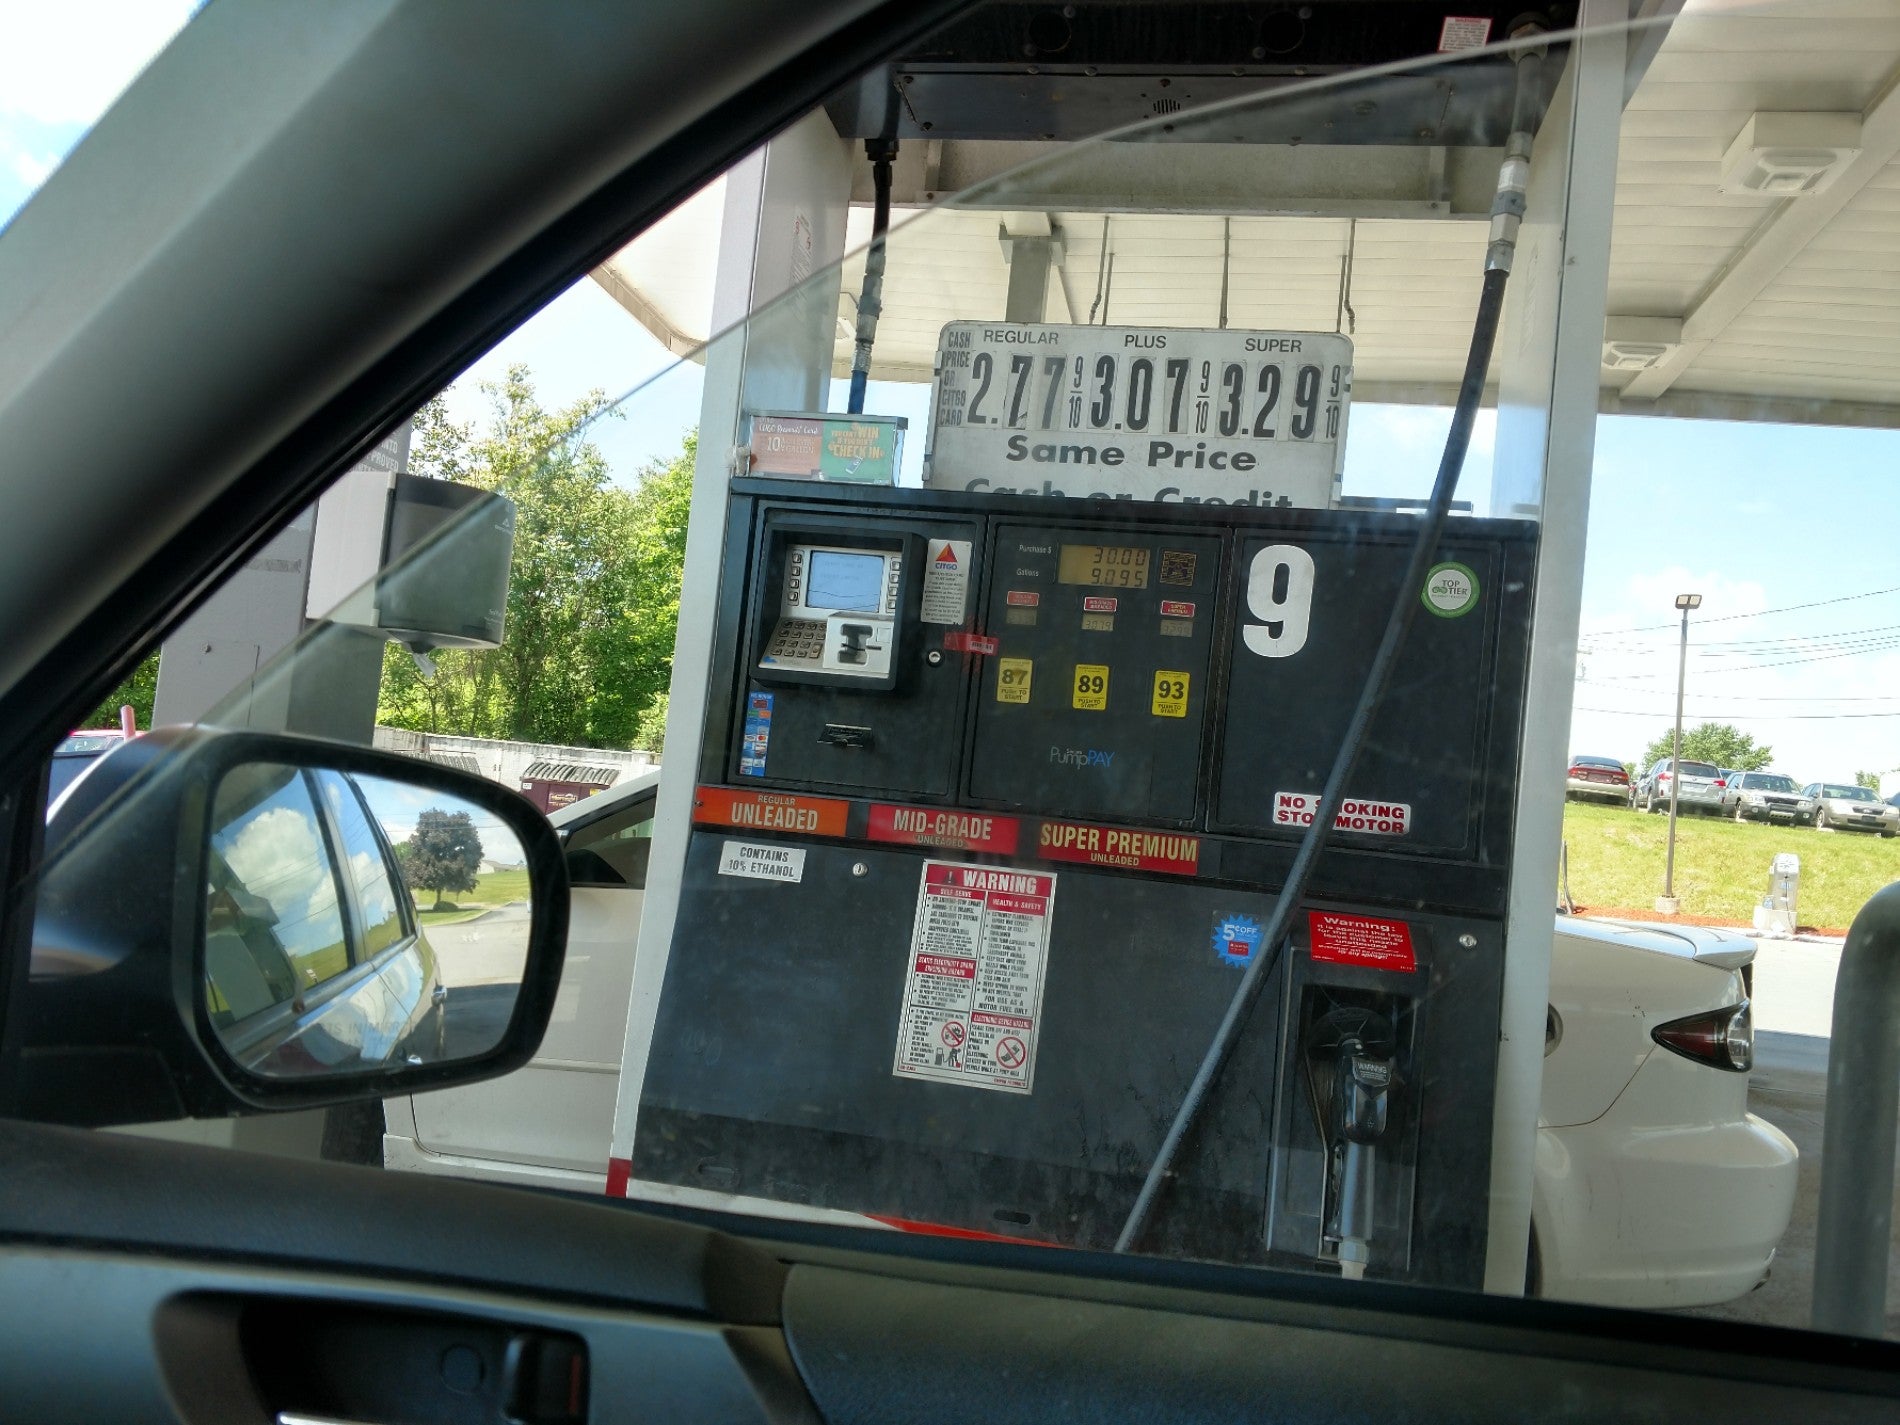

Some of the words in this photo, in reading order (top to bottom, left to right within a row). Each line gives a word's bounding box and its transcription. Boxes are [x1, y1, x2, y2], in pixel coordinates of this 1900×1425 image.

[948, 331, 971, 348] CASH
[983, 330, 1059, 344] REGULAR
[1124, 335, 1167, 349] PLUS
[1245, 338, 1302, 353] SUPER
[945, 351, 970, 368] PRICE
[944, 370, 955, 386] OR
[967, 352, 1066, 429] 2.77
[1091, 355, 1189, 432] 3.07
[1220, 364, 1321, 439] 3.29
[940, 409, 962, 426] CARD
[1005, 434, 1125, 466] Same
[1148, 441, 1257, 471] Price
[1019, 545, 1047, 554] Purchase
[1093, 546, 1147, 566] 30.00
[935, 562, 958, 570] CITGO
[1017, 568, 1039, 577] Gallons
[1442, 580, 1460, 588] TOP
[1448, 587, 1468, 595] TIER
[1243, 544, 1315, 658] 9
[1002, 669, 1029, 685] 87
[1078, 675, 1104, 694] 89
[1159, 680, 1184, 700] 93
[757, 795, 796, 805] REGULAR
[1280, 796, 1306, 809] NO
[731, 802, 818, 831] UNLEADED
[1277, 810, 1314, 824] STO
[1336, 815, 1405, 833] MOTOR
[893, 809, 993, 841] MID-GRADE
[917, 835, 964, 848] UNLEADED
[1040, 823, 1100, 851] SUPER
[1106, 831, 1198, 862] PREMIUM
[740, 847, 789, 863] CONTAINS
[1091, 852, 1139, 866] UNLEADED
[728, 859, 746, 872] 10%
[751, 862, 794, 877] ETHANOL
[963, 870, 1037, 895] WARNING
[955, 890, 972, 898] SERVE
[992, 899, 1013, 907] HEALTH
[1021, 902, 1041, 911] SAFETY
[1324, 917, 1395, 932] Warning:
[1336, 926, 1368, 935] against
[1349, 932, 1391, 941] customer
